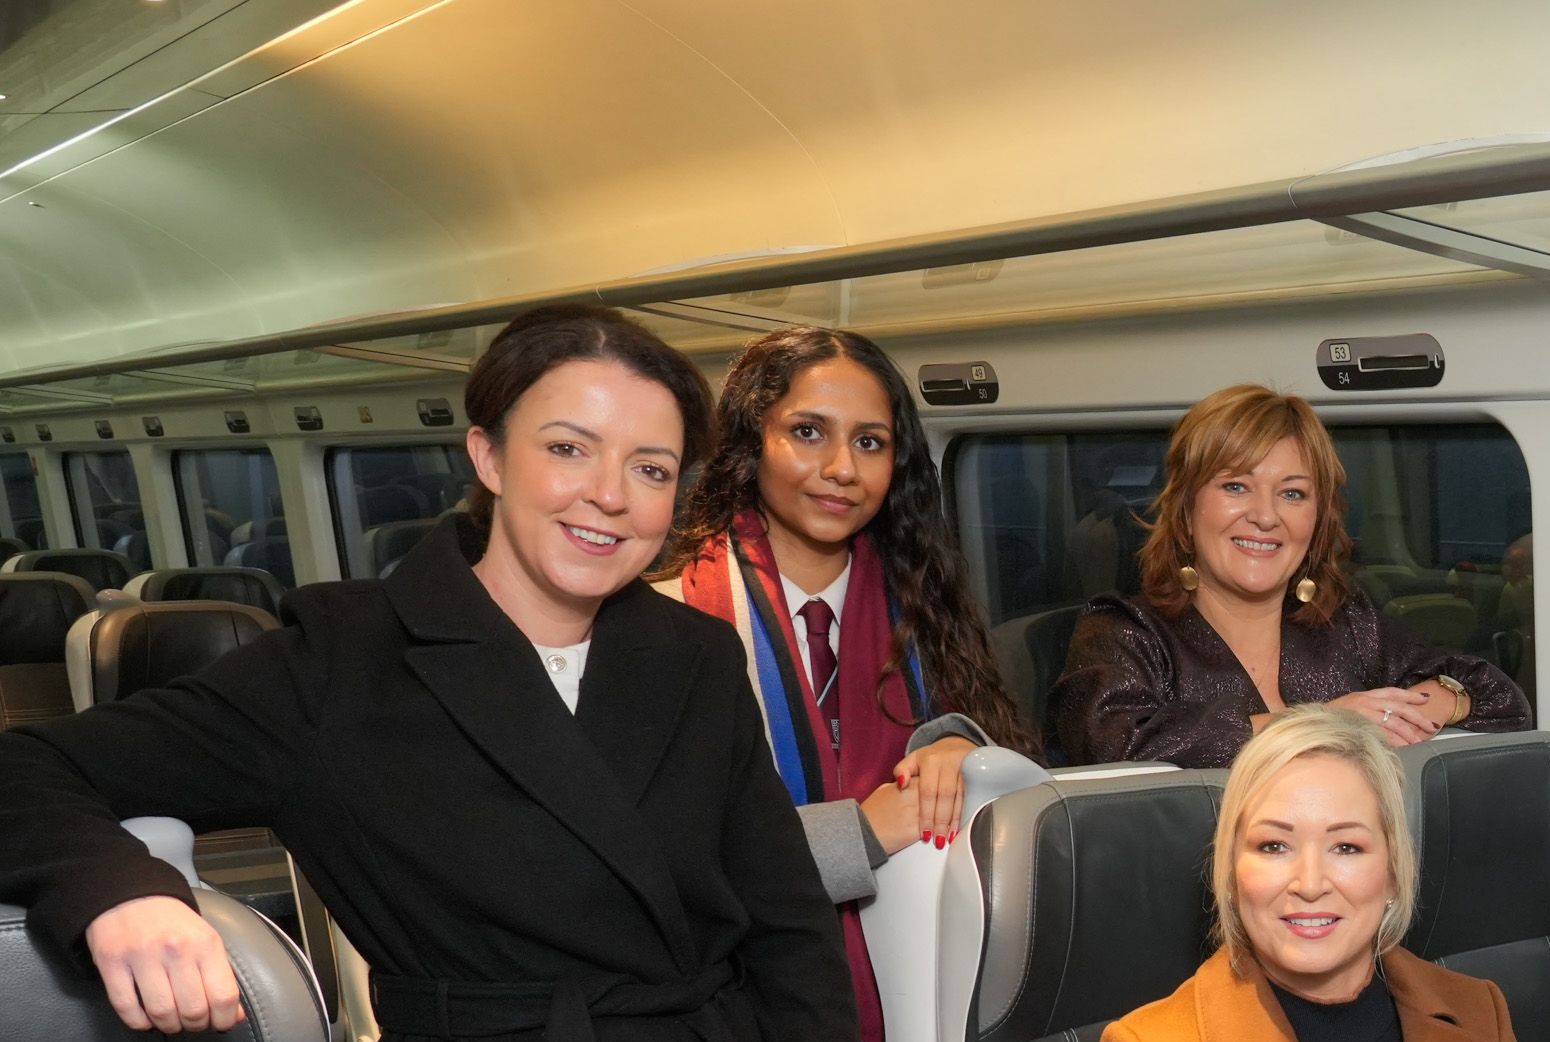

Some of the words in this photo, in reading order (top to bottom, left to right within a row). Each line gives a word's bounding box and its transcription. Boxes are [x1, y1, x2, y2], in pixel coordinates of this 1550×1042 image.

[1334, 346, 1347, 360] 53
[974, 367, 984, 378] 49
[1338, 371, 1350, 385] 54
[978, 388, 988, 399] 50
